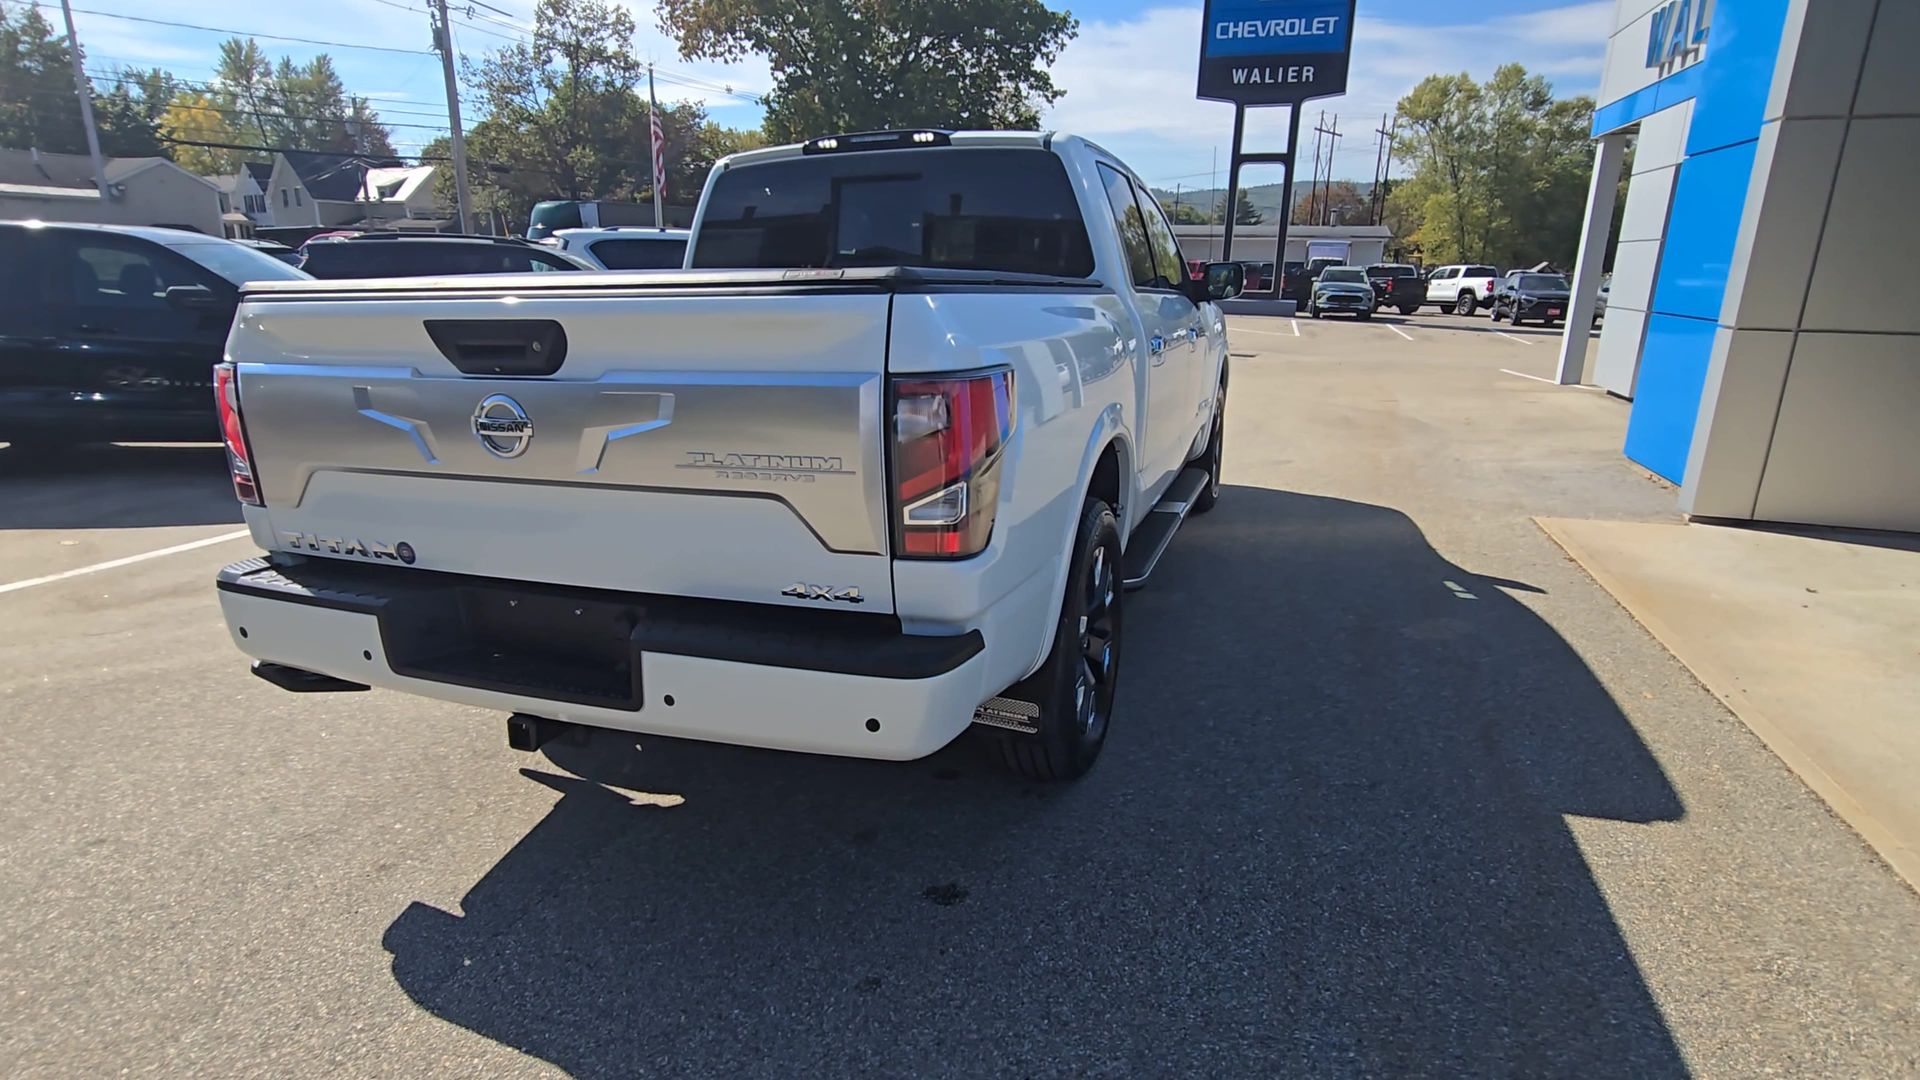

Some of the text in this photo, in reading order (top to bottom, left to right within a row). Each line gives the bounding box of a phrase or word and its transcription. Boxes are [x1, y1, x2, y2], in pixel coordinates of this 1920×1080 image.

[1216, 17, 1339, 39] CHEVROLET
[1232, 66, 1315, 84] WALIER
[479, 421, 524, 433] NISSAN
[686, 451, 842, 471] PLATINUM
[715, 471, 816, 483] RESERVE
[281, 531, 399, 561] TITAN
